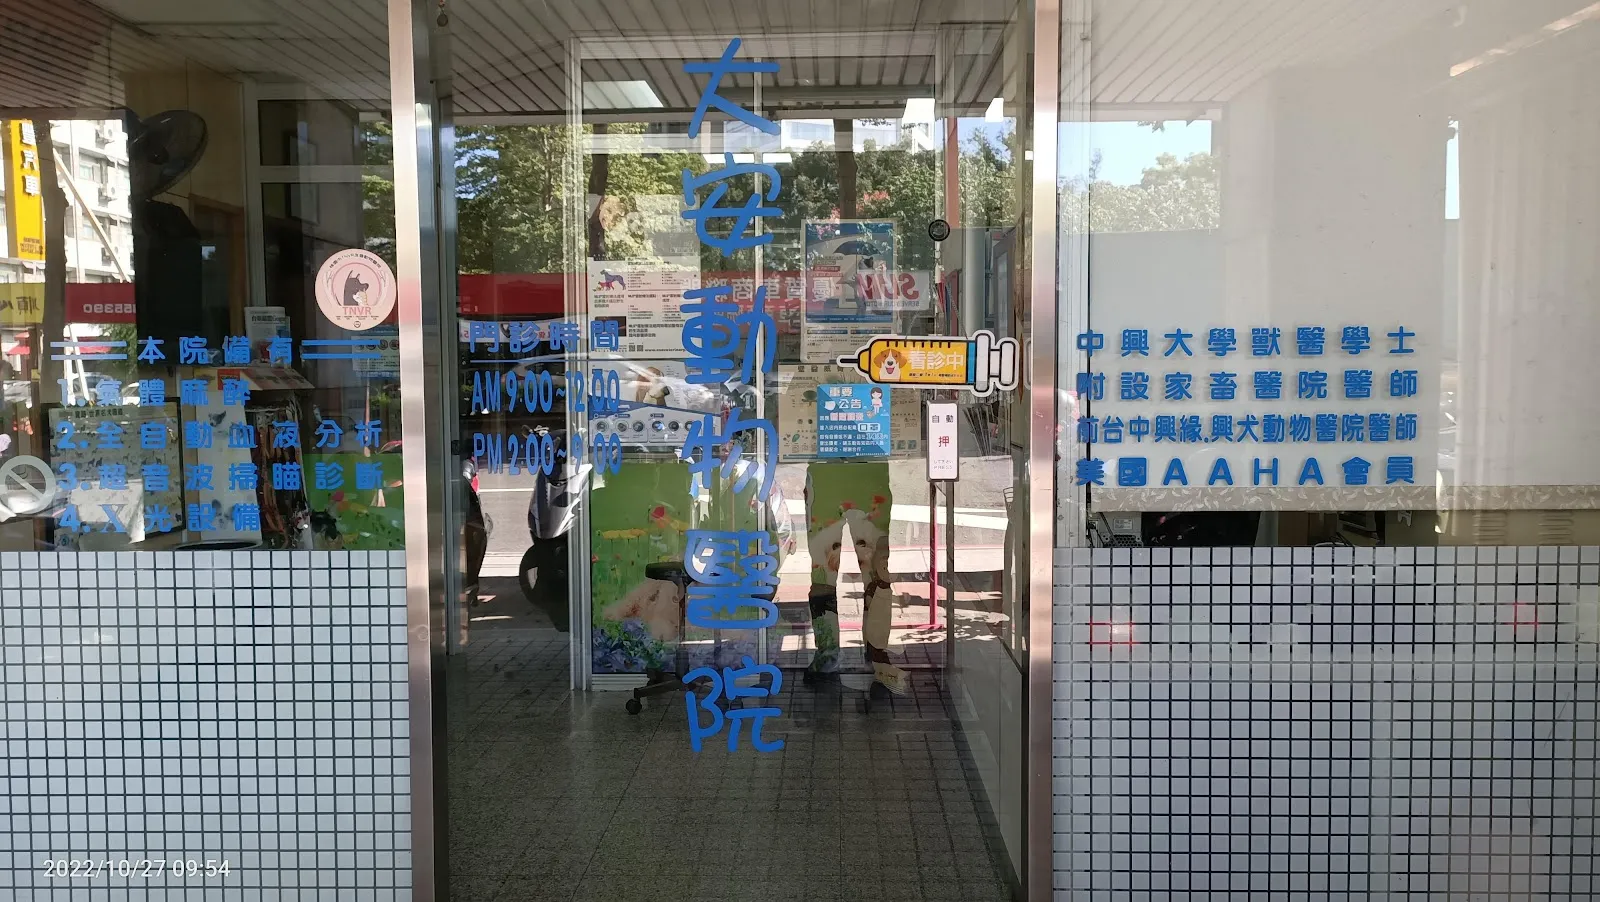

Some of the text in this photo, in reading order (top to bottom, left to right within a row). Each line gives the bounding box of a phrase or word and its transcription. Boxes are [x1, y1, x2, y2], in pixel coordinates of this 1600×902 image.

[342, 306, 372, 316] TNVR
[138, 336, 293, 365] 本院備有
[469, 320, 619, 353] 門診時間
[1077, 326, 1415, 357] 中興大學獸醫學士
[908, 345, 964, 370] 看診中
[472, 370, 501, 413] AM
[680, 38, 785, 752] 大安動物醫院
[1077, 369, 1418, 401] 附設家畜醫院醫師
[838, 398, 862, 409] 公告
[931, 414, 954, 424] 自動
[1077, 413, 1418, 445] 前台中興緣.興犬動物醫院醫師
[57, 420, 382, 450] 2.全自動血液分析
[938, 435, 950, 448] 押
[473, 432, 622, 475] PM 2:00~900
[57, 462, 383, 492] 3.超音波掃瞄診斷
[58, 503, 261, 534] 4.X光設備
